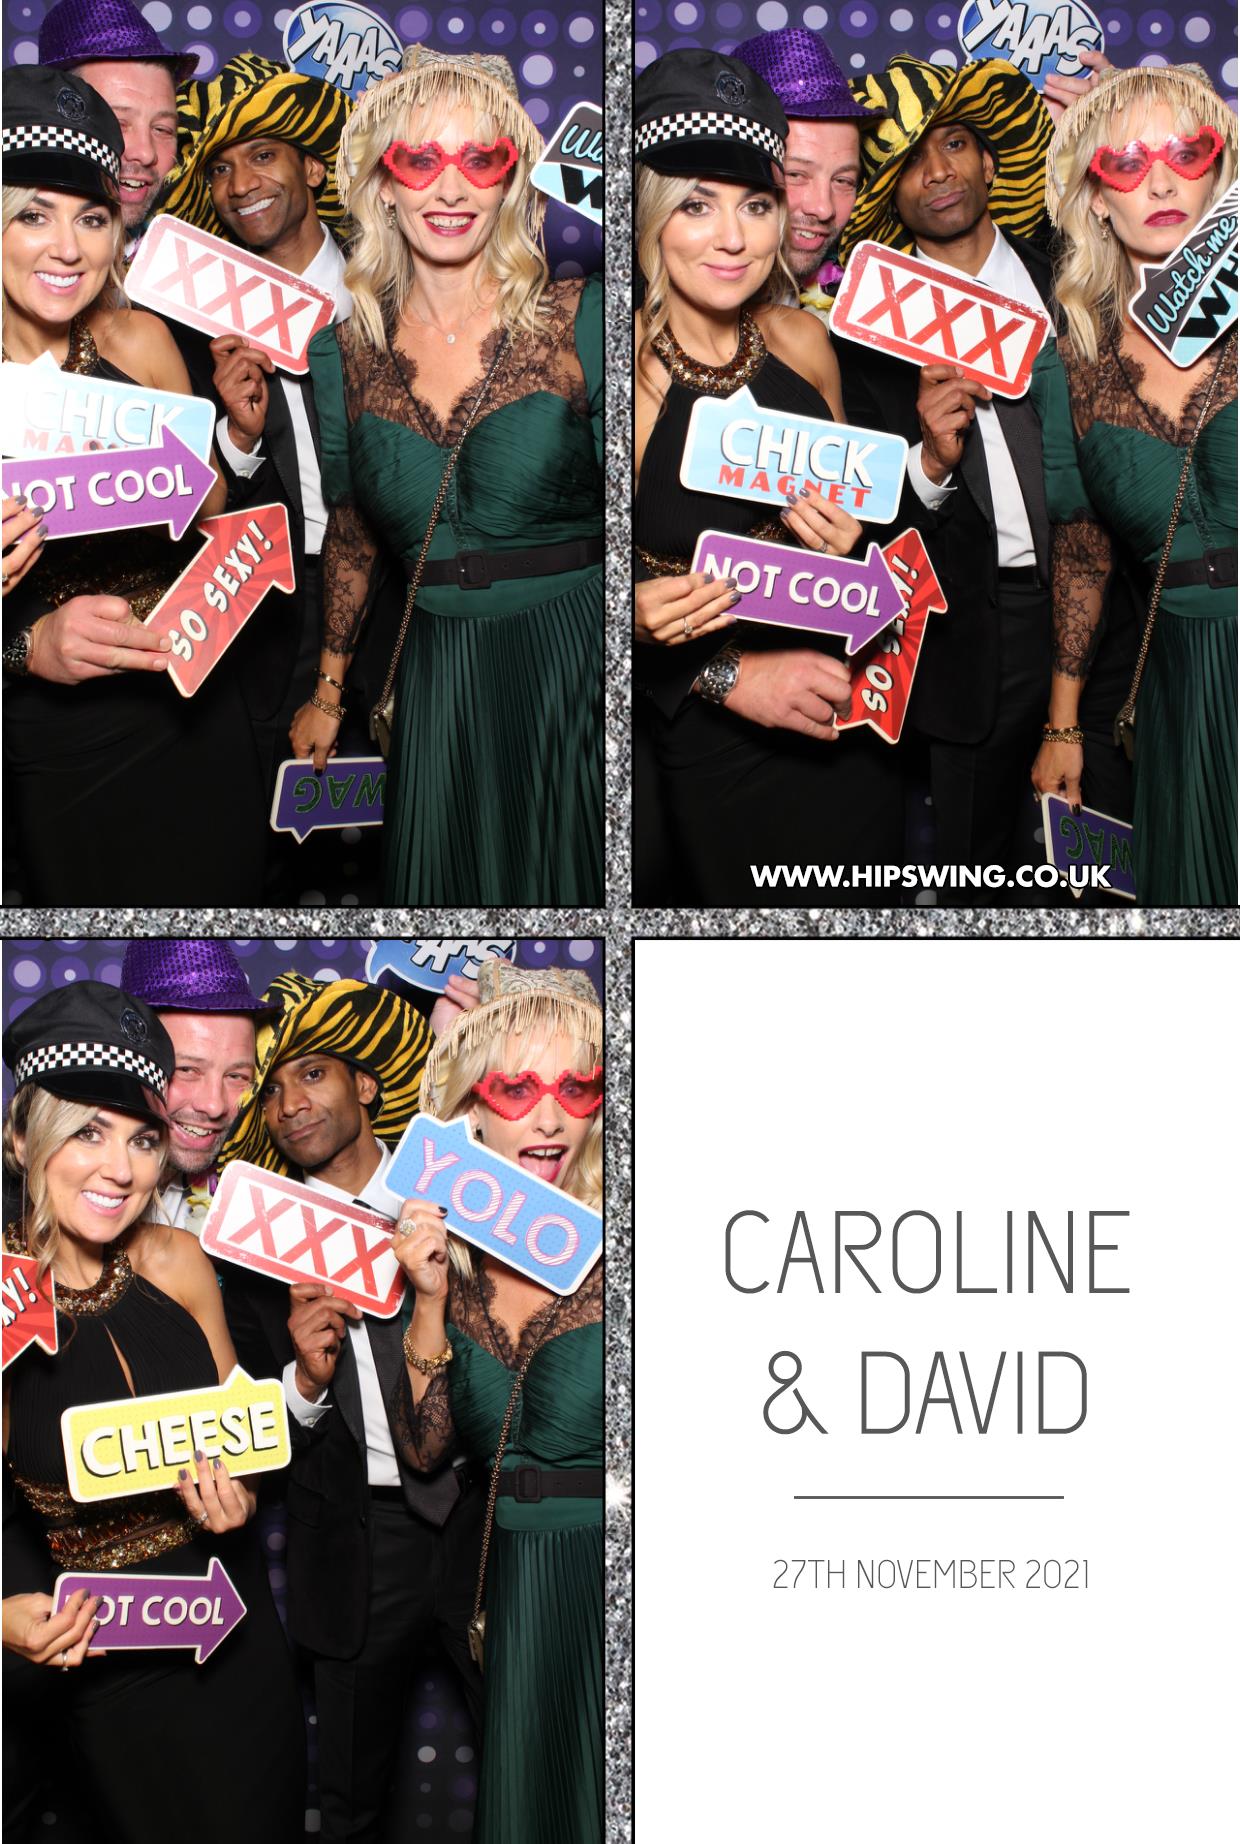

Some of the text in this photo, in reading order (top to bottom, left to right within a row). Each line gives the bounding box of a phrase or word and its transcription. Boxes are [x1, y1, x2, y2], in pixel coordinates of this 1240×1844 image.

[962, 0, 1102, 76] YAAAS
[158, 239, 313, 354] XXX
[860, 263, 1026, 378] XXX
[1146, 244, 1212, 334] Watch
[25, 389, 185, 448] CHICK
[721, 419, 879, 488] CHICK
[88, 464, 193, 507] COOL
[168, 519, 273, 662] SO SEXY!
[703, 553, 881, 617] NOT COOL
[861, 664, 894, 713] SO
[414, 1136, 580, 1267] YOLO
[227, 1184, 392, 1298] XXX
[80, 1401, 279, 1477] CHEESE
[66, 1594, 225, 1626] OT COOL
